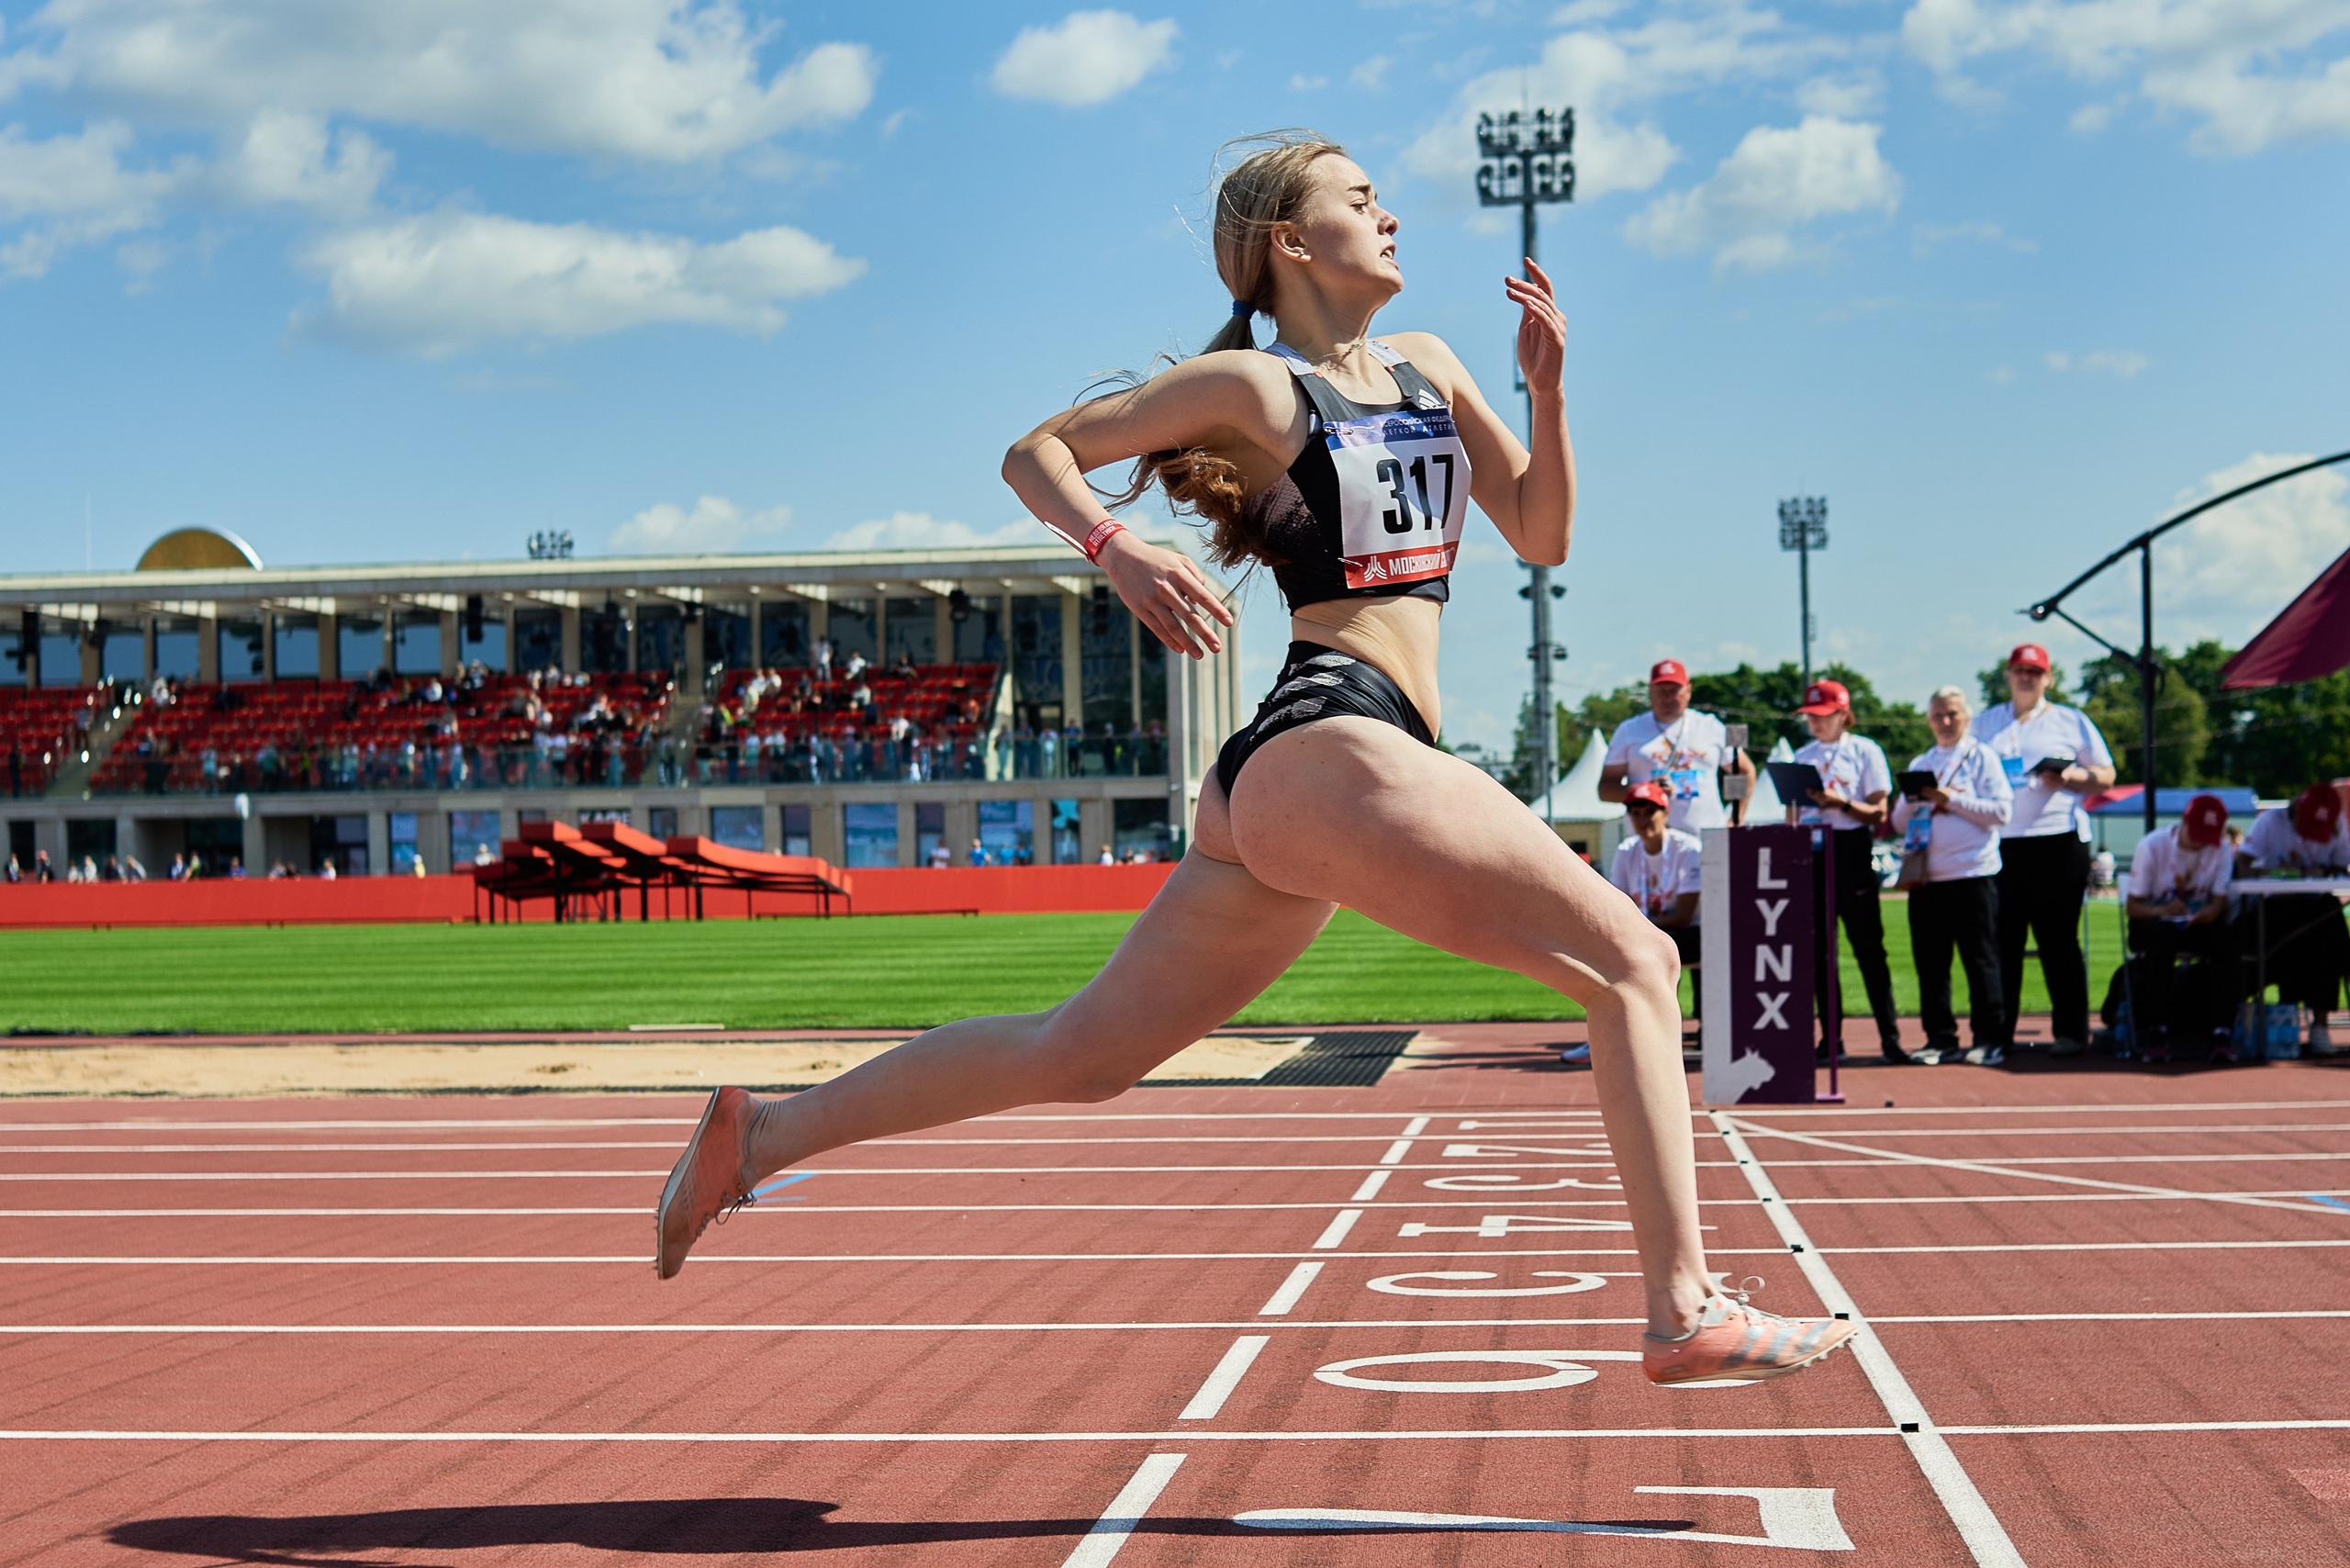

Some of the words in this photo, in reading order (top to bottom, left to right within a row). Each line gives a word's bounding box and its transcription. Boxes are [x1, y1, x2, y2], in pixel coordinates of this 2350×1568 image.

[1376, 454, 1453, 534] 317
[1752, 846, 1792, 1030] LYNX
[1423, 1175, 1624, 1192] 3
[1397, 1215, 1718, 1238] 4
[1366, 1271, 1740, 1297] 5
[1313, 1350, 1765, 1394] 6
[1232, 1485, 1856, 1551] 7
